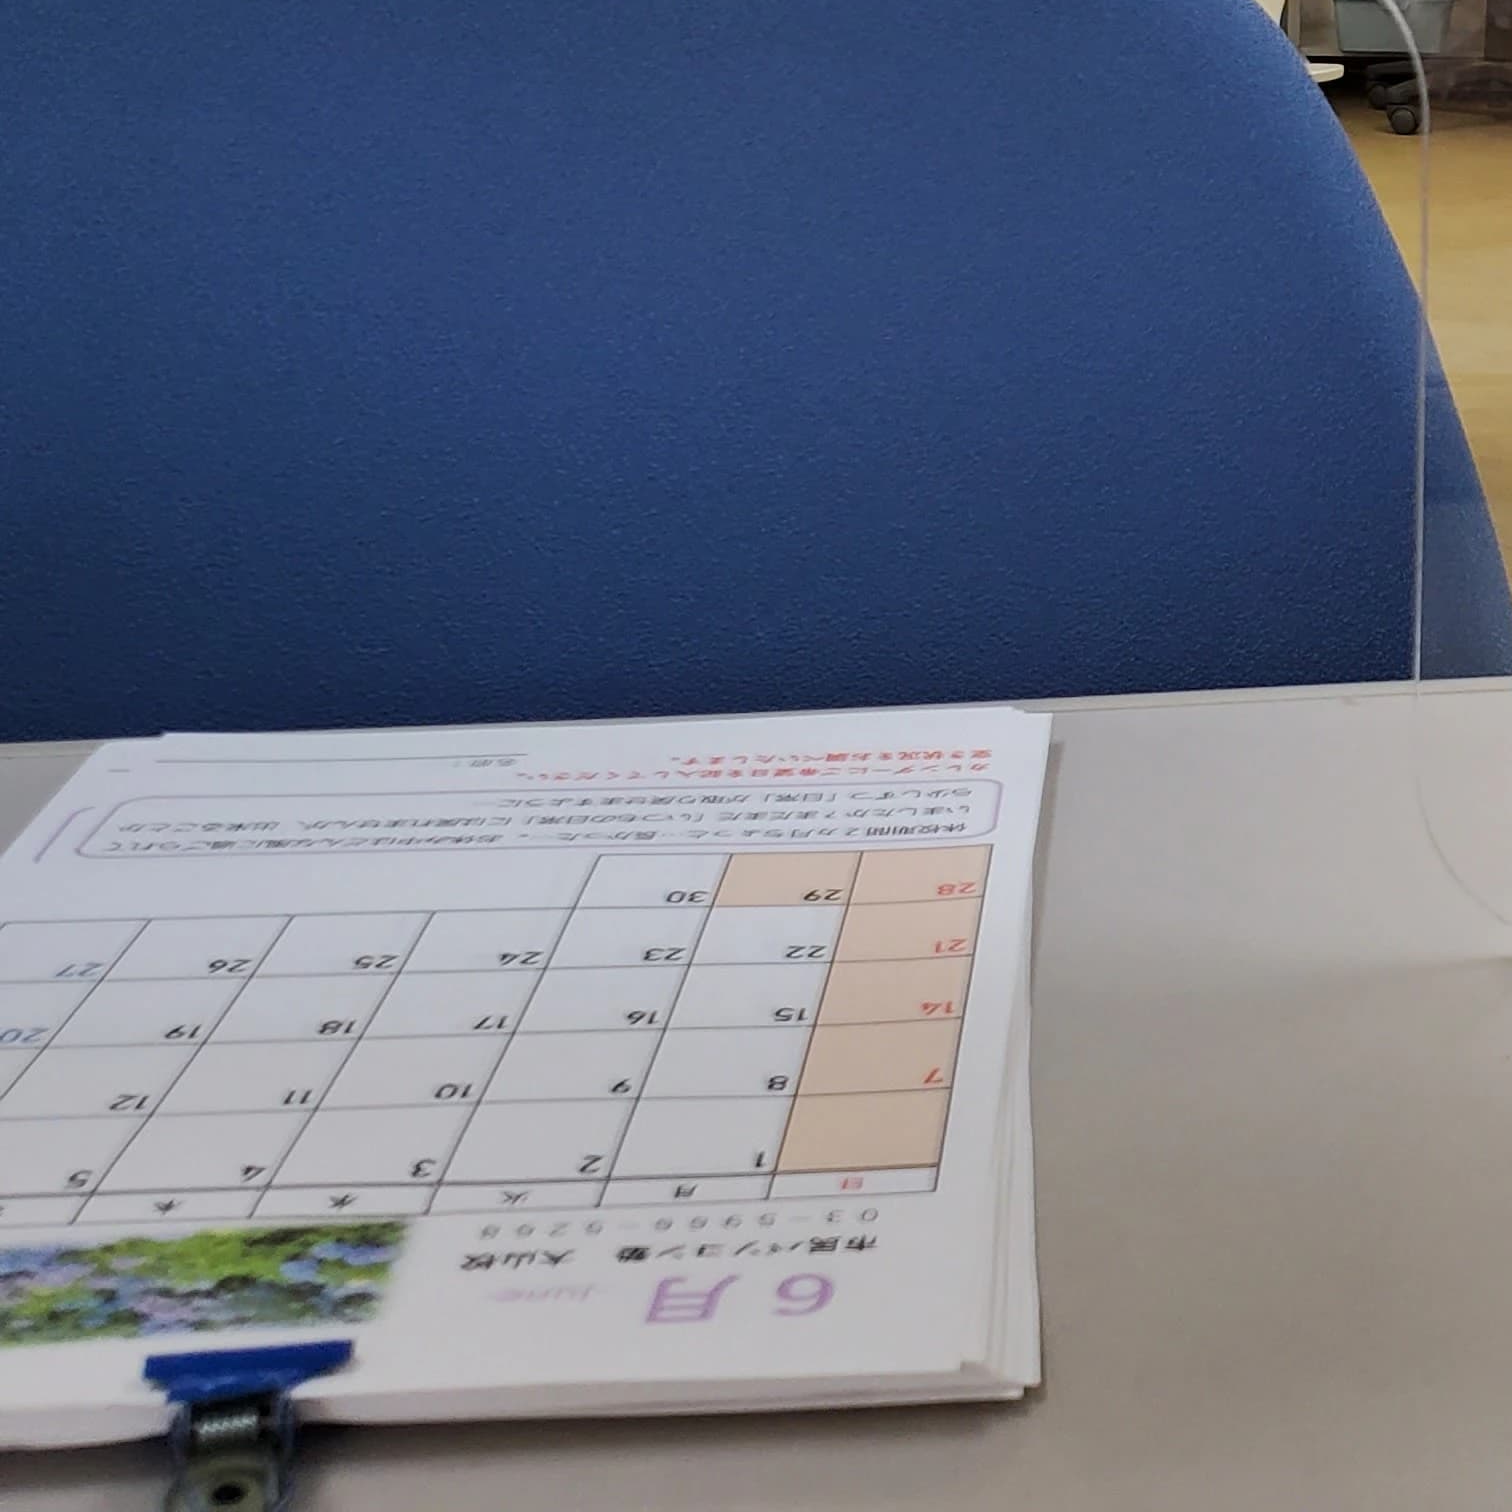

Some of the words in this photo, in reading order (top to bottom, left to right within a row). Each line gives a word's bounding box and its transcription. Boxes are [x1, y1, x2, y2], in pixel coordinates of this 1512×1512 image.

[665, 890, 708, 905] 30
[803, 888, 844, 902] 29
[936, 882, 976, 897] 28
[642, 947, 686, 962] 23
[784, 945, 826, 959] 22
[934, 939, 967, 954] 21
[207, 959, 252, 974] 26
[352, 954, 399, 971] 25
[499, 951, 544, 967] 24
[54, 963, 103, 978] 27
[773, 1007, 808, 1024] 15
[920, 1001, 955, 1016] 14
[473, 1015, 509, 1031] 17
[626, 1010, 661, 1026] 16
[163, 1024, 201, 1039] 19
[317, 1020, 357, 1036] 18
[768, 1075, 788, 1091] 8
[923, 1068, 943, 1084] 7
[434, 1084, 474, 1100] 10
[611, 1078, 633, 1095] 9
[109, 1095, 150, 1111] 12
[282, 1089, 313, 1106] 11
[578, 1154, 603, 1173] 2
[753, 1151, 767, 1168] 1
[241, 1165, 266, 1182] 4
[410, 1159, 437, 1178] 3
[66, 1171, 93, 1188] 5
[840, 1177, 864, 1190] 日
[503, 1191, 528, 1205] 火
[673, 1184, 696, 1200] 月
[645, 1274, 835, 1325] 6月
